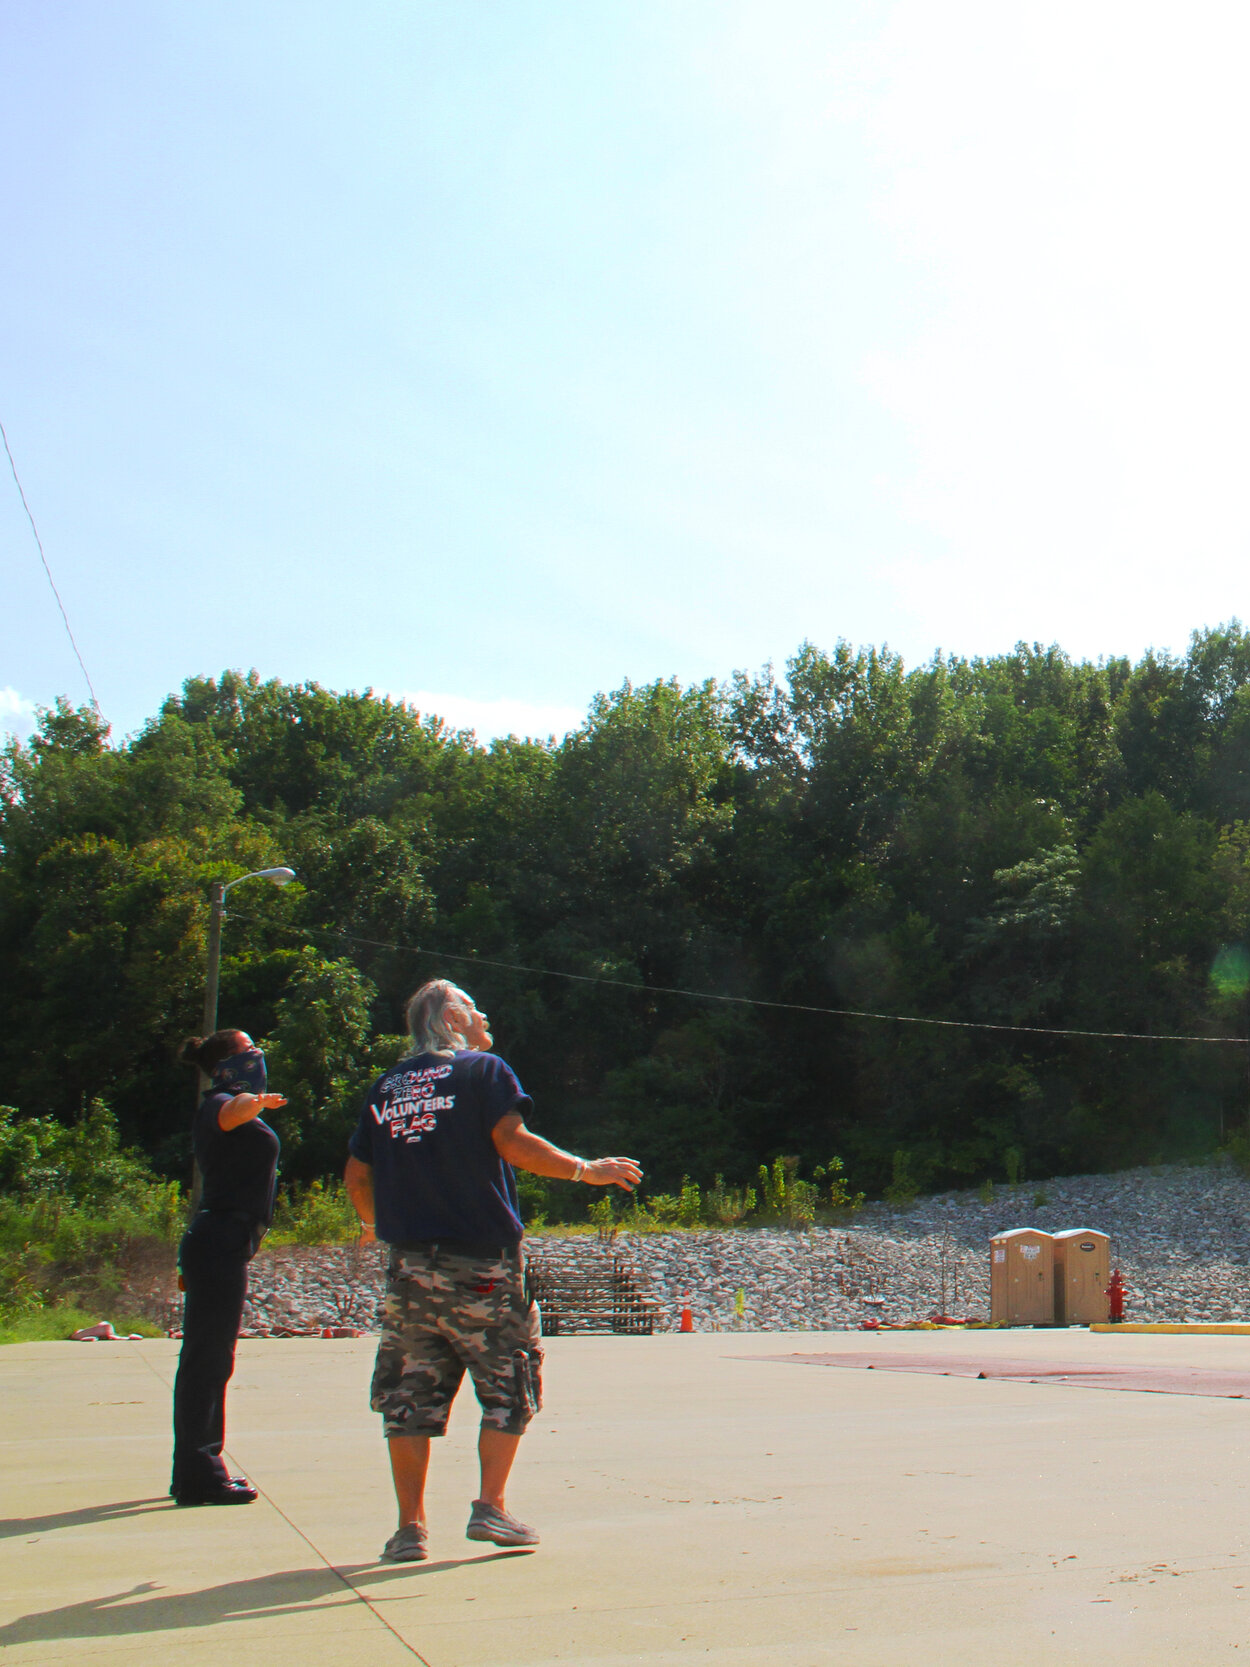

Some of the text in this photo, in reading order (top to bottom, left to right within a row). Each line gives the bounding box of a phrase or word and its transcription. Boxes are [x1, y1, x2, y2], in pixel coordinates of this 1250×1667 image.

[380, 1064, 453, 1093] GROUND
[392, 1082, 435, 1104] ZERO
[390, 1113, 437, 1138] FLAG
